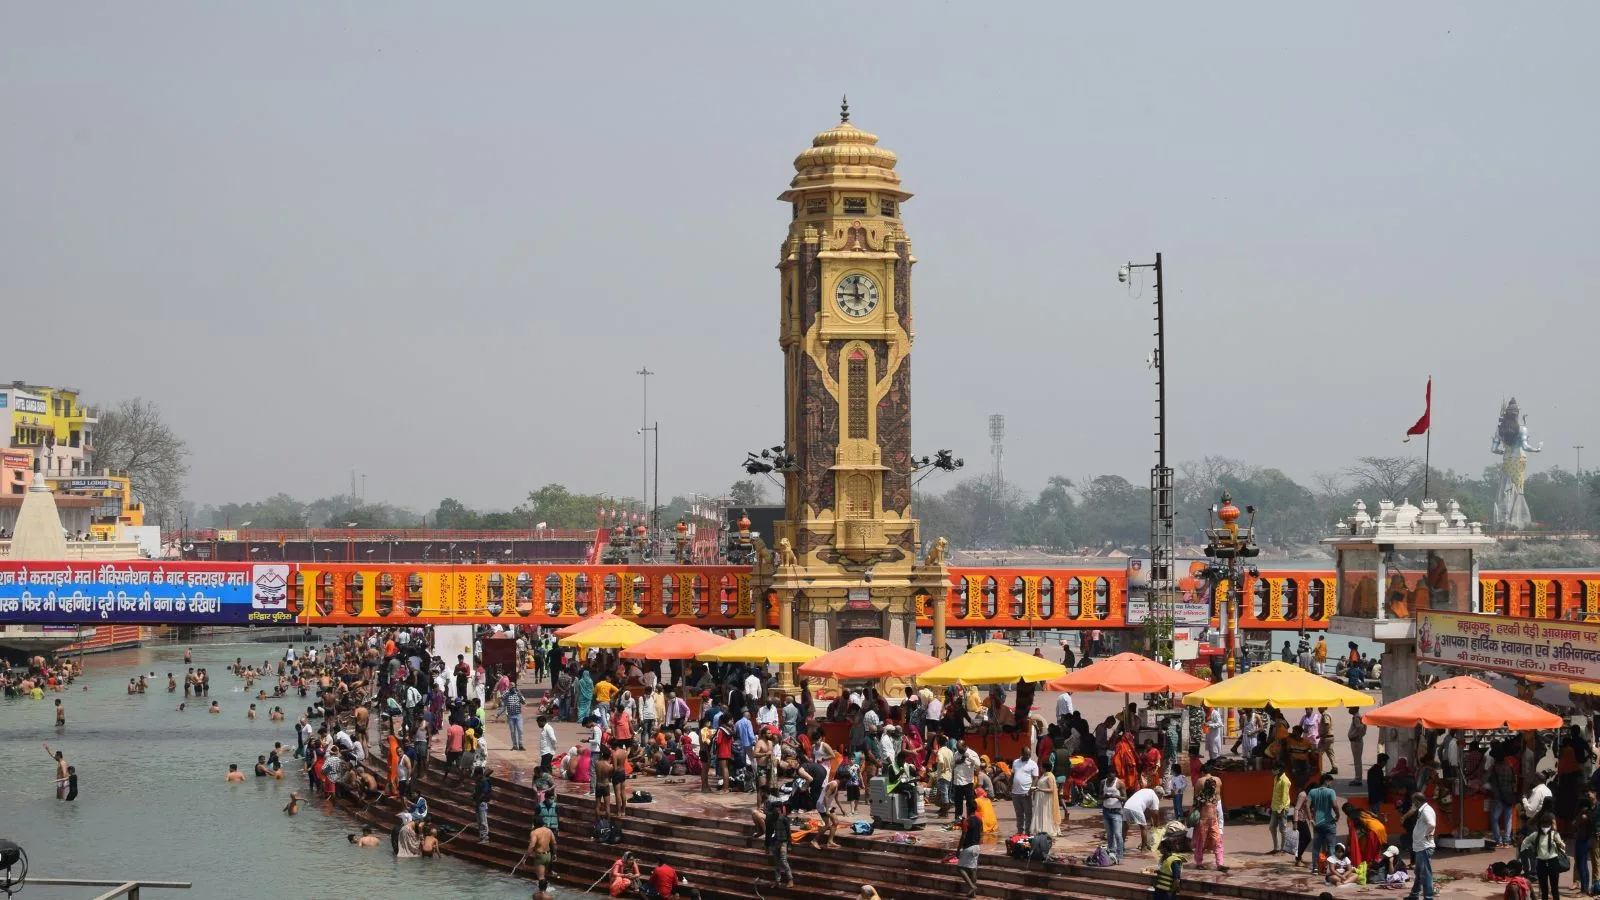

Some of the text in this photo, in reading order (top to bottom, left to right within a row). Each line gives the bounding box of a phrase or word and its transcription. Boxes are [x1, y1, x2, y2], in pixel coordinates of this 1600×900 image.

[18, 566, 27, 585] से
[30, 565, 72, 587] कतराइये
[153, 566, 164, 585] के
[167, 571, 185, 585] बाद
[187, 571, 225, 588] इतराइए
[22, 591, 42, 611] फिर
[43, 591, 56, 612] भी
[98, 590, 114, 618] दूरी
[118, 590, 137, 611] फिर
[139, 590, 151, 612] भी
[154, 597, 173, 612] बना
[175, 592, 187, 612] के
[248, 612, 292, 622] हरिद्वार पुलिस
[1441, 635, 1469, 649] आपका
[1471, 634, 1499, 652] हार्दिक
[1501, 641, 1532, 655] स्वागत
[1535, 640, 1550, 657] एवं
[1542, 628, 1580, 641] आगमन
[1584, 631, 1598, 642] पर
[1457, 651, 1468, 661] श्री
[1470, 654, 1490, 664] गंगा
[1492, 657, 1513, 667] सभा
[1549, 662, 1586, 674] हरिद्वार
